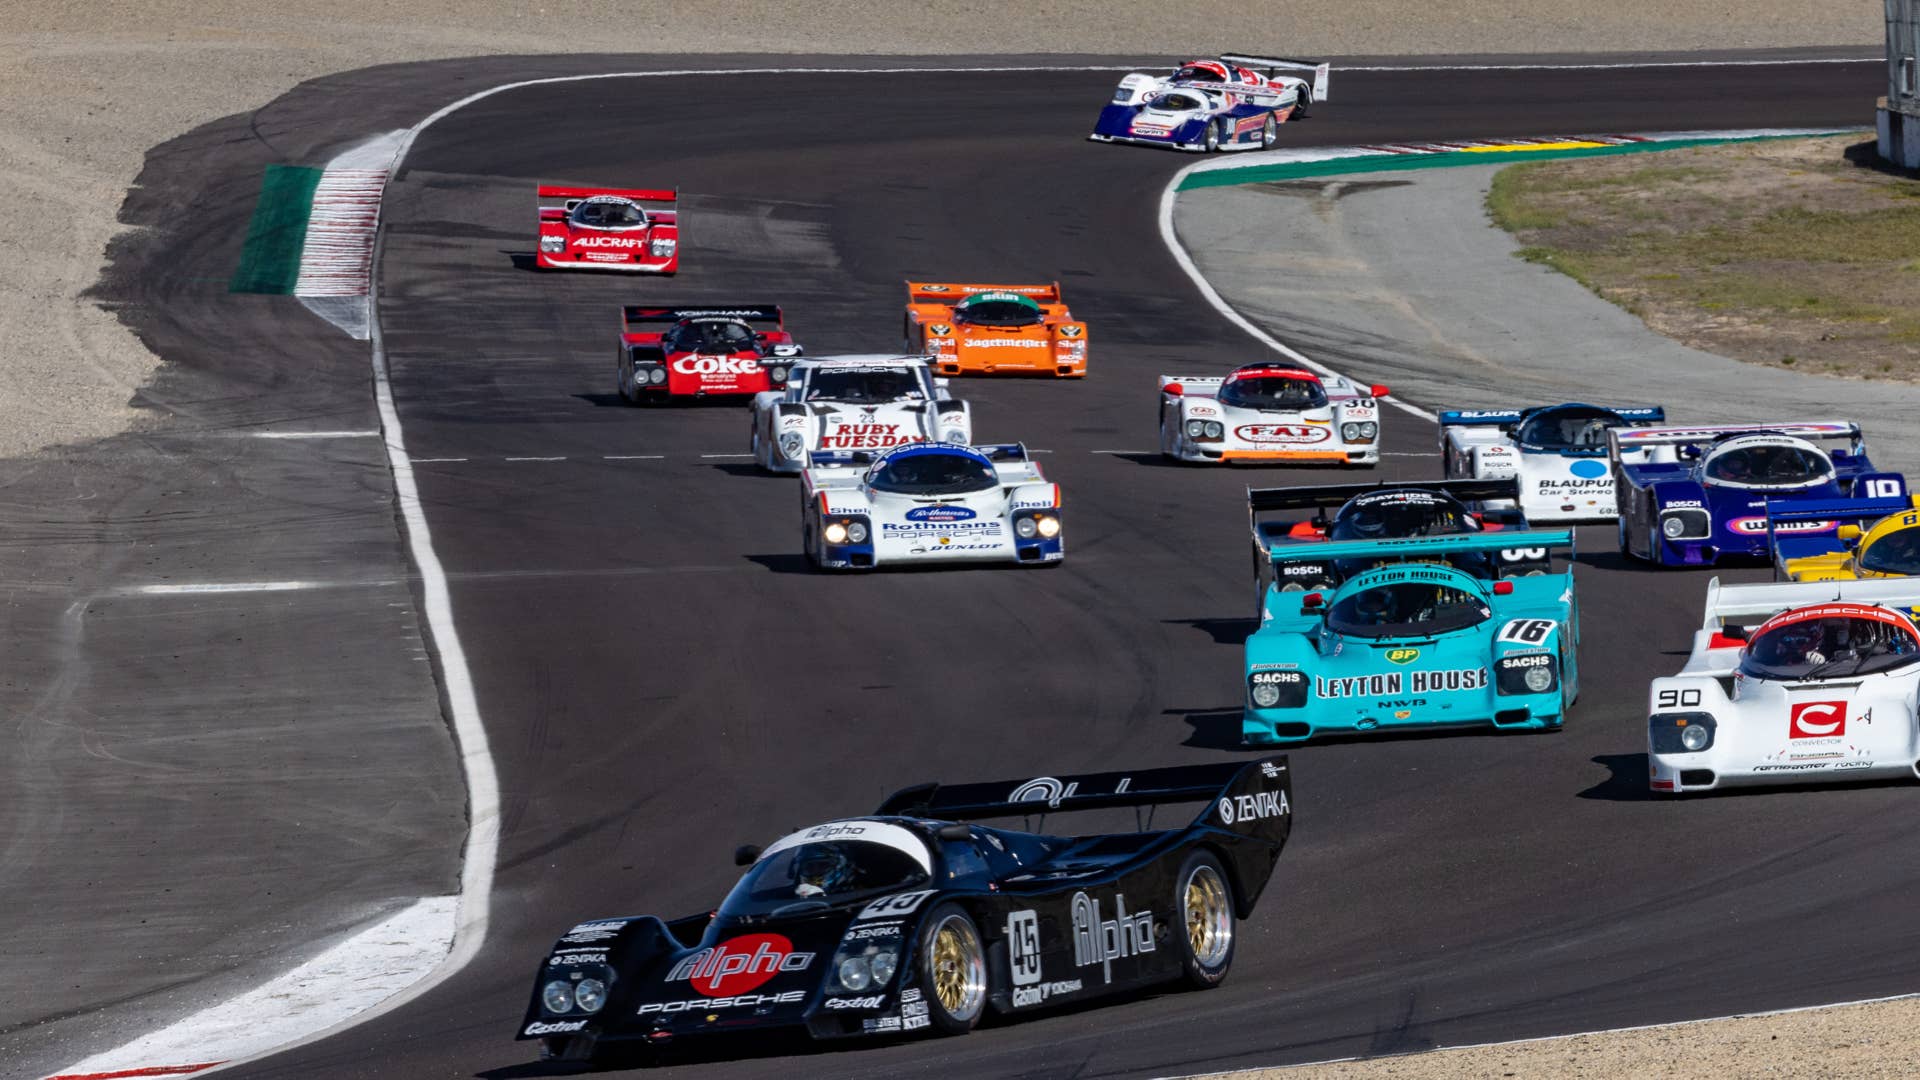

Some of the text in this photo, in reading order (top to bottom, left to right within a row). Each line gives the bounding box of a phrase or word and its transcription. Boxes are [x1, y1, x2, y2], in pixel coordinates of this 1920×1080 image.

[572, 237, 643, 248] ALUCRAFT
[673, 354, 758, 374] Coke
[836, 424, 900, 435] RUBY
[820, 435, 927, 449] TUESDAY
[884, 443, 981, 459] PORSCHE
[1866, 479, 1901, 499] 10
[882, 521, 1001, 530] Rothmans
[883, 529, 1002, 539] PORSCHE
[928, 543, 1004, 552] DUNLOP
[1284, 566, 1323, 575] BOSCH
[1358, 569, 1455, 587] LEYTON HOUSE
[1769, 606, 1896, 628] PORSCHE
[1504, 619, 1553, 642] 16
[1390, 650, 1417, 660] BP
[1503, 655, 1550, 668] SACHS
[1253, 673, 1301, 683] SACHS
[1315, 666, 1488, 699] LEYTON HOUSE
[1377, 698, 1427, 708] NWB
[1658, 689, 1702, 708] 90
[804, 824, 866, 839] Alpha
[1070, 891, 1156, 985] Alpha
[1013, 916, 1038, 978] 45
[664, 942, 817, 990] Alpha
[637, 990, 807, 1015] PORSCHE
[824, 994, 887, 1009] Castrol
[523, 1019, 589, 1036] Castrol
